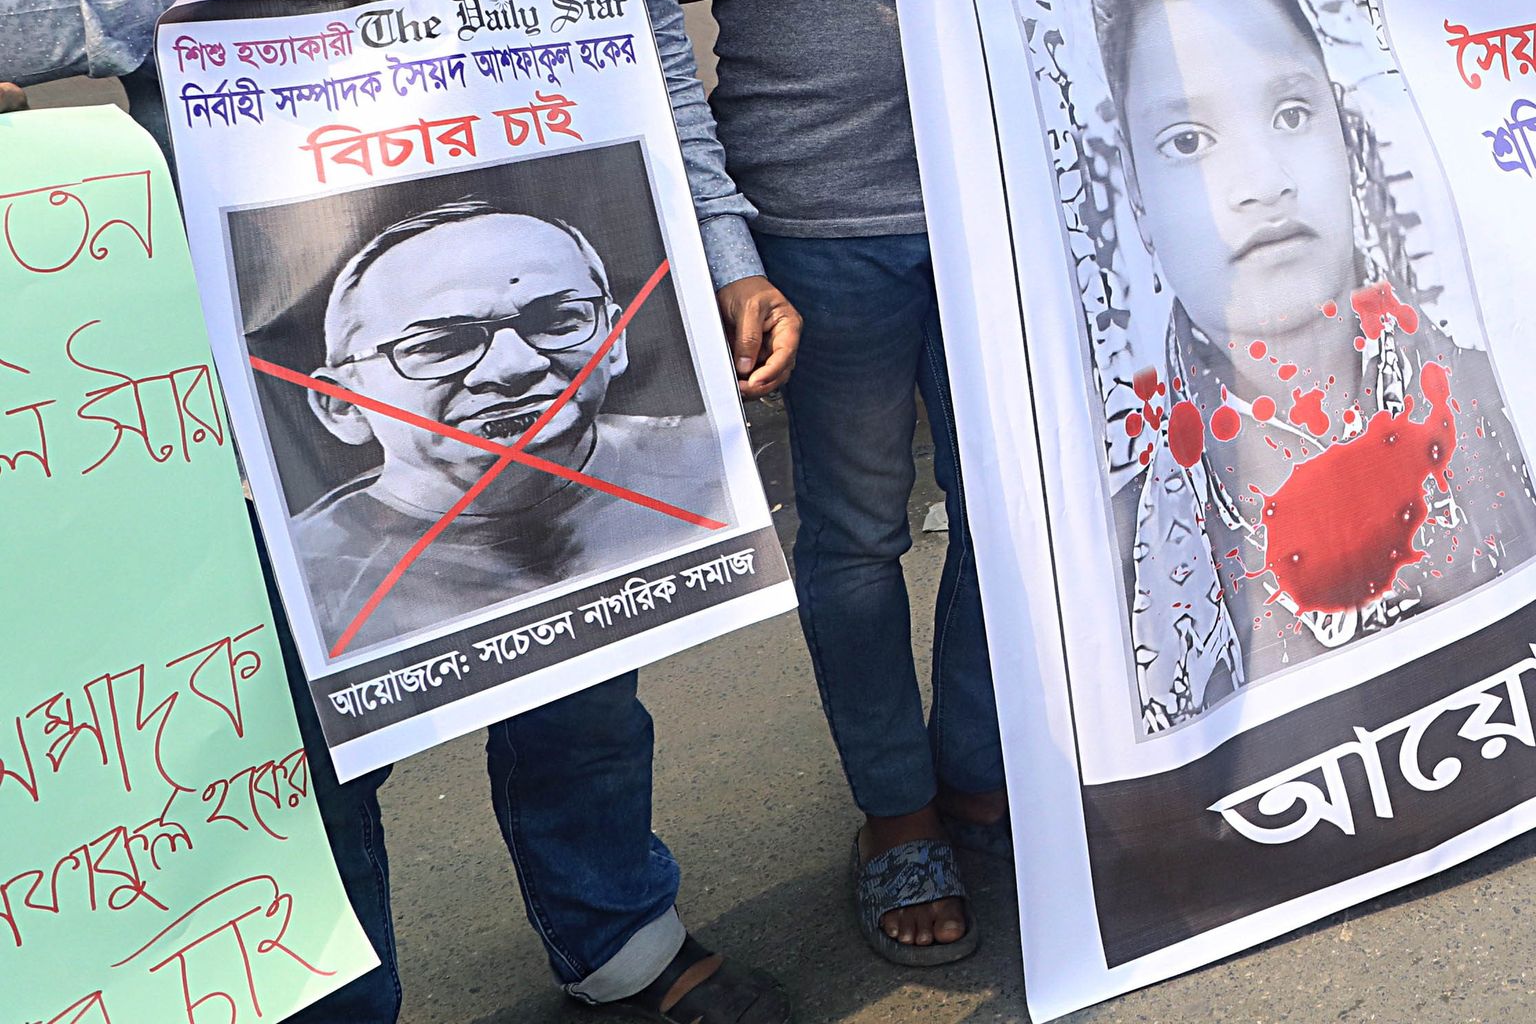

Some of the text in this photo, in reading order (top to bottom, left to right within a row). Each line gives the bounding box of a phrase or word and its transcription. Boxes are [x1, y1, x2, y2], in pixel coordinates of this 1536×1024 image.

[172, 35, 227, 73] শিশু
[236, 22, 355, 71] হত্যাকারী
[355, 10, 442, 49] The
[180, 33, 638, 129] নির্বাহী সম্পাদক সৈয়দ আশফাকুল হকের
[299, 90, 584, 184] বিচার চাই
[328, 547, 757, 718] আয়োজনে: সচেতন নাগরিক সমাজ
